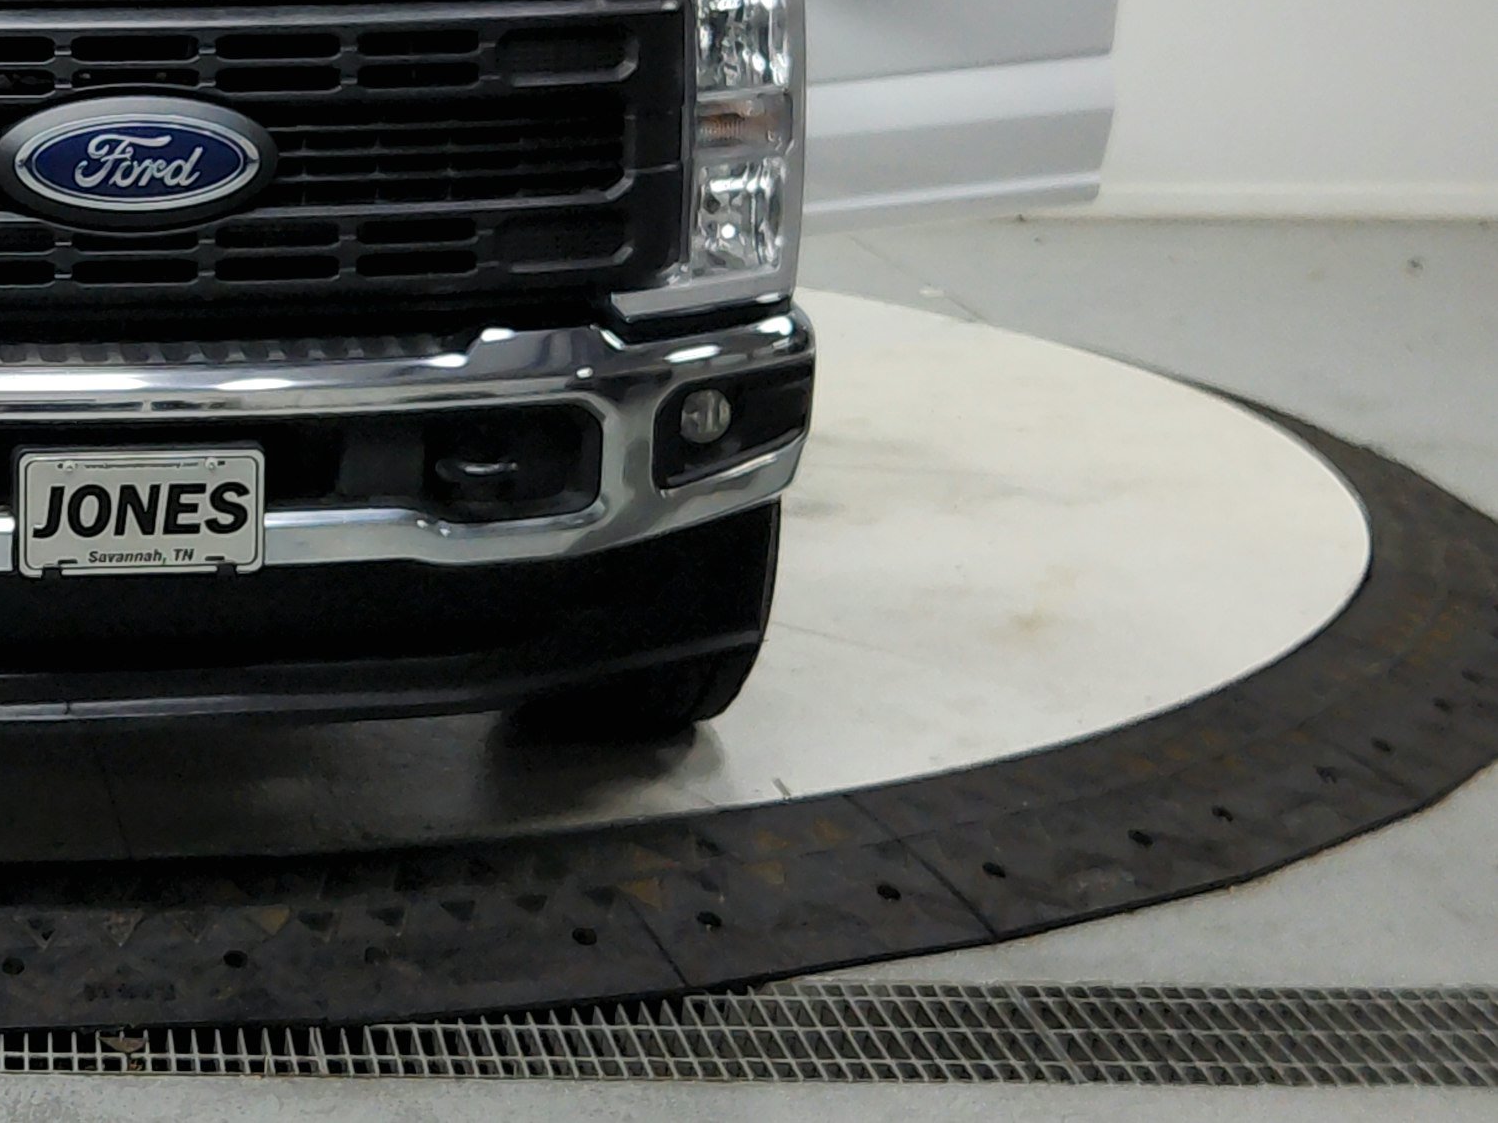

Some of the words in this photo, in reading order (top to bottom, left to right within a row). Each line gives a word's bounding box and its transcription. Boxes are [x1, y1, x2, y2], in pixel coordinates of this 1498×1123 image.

[74, 134, 203, 188] Ford
[32, 481, 250, 538] JONES
[88, 549, 167, 564] Savannah,
[173, 548, 195, 562] TN
